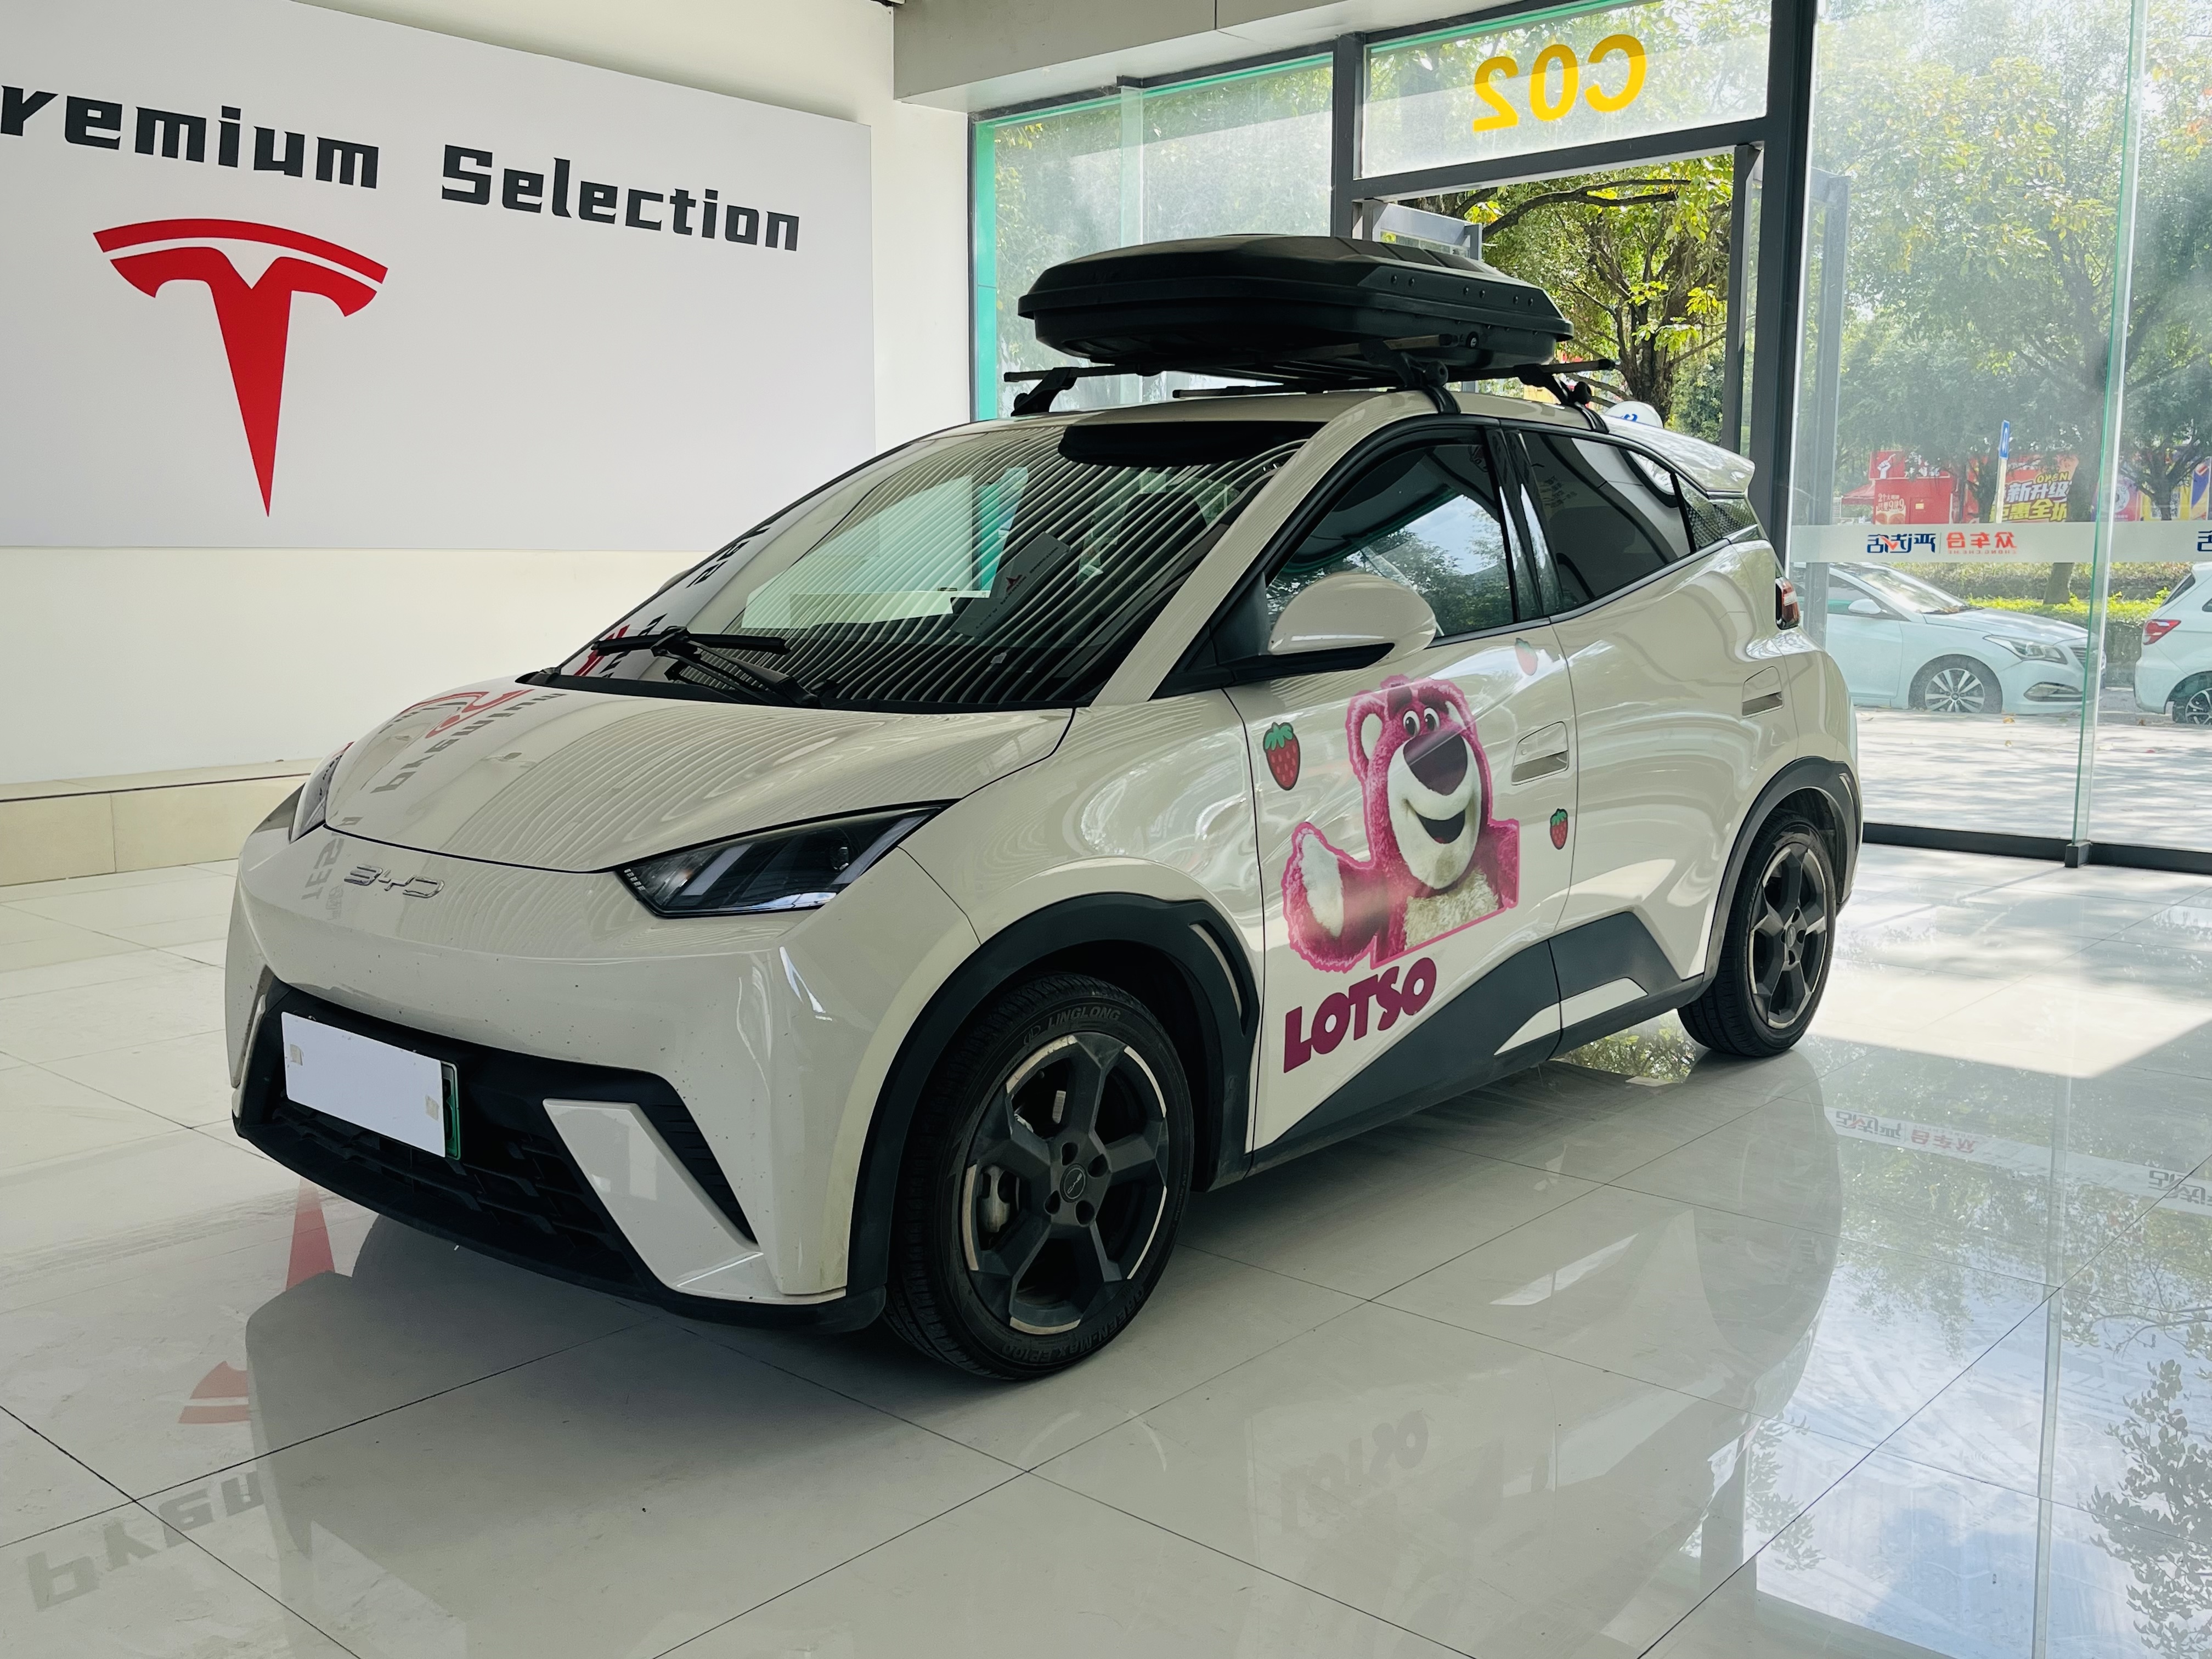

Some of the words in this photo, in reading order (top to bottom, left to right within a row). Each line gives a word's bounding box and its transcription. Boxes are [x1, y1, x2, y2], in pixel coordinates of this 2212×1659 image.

[441, 144, 799, 251] Selection
[343, 863, 445, 899] BYD
[1047, 1006, 1121, 1029] LINGLONG
[1283, 957, 1437, 1073] LOTSO
